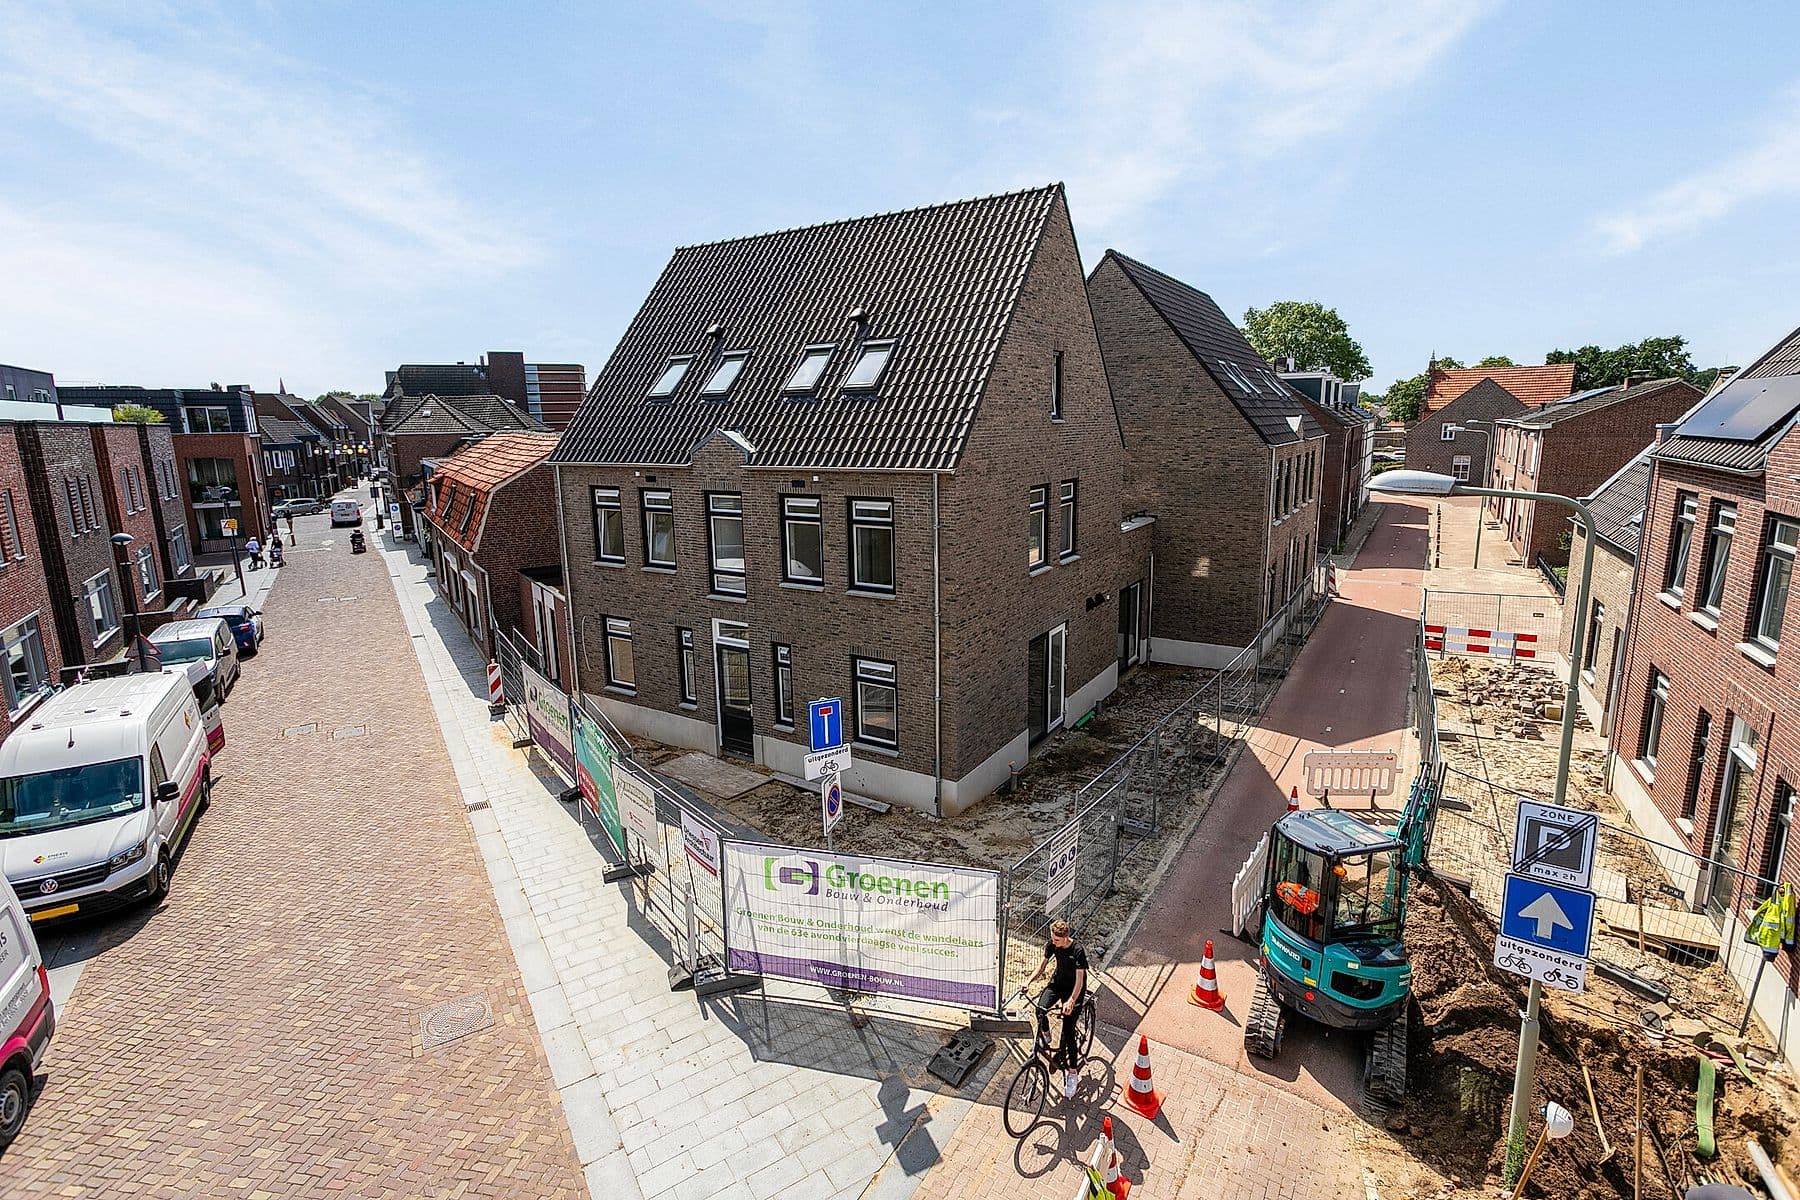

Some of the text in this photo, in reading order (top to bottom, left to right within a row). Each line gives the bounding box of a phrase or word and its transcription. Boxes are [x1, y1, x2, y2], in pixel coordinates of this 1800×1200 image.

[807, 747, 848, 762] uitgezonderd
[1540, 809, 1575, 823] ZONE
[826, 864, 950, 900] Groenen
[1533, 865, 1577, 882] max 2h
[826, 889, 949, 912] Bouw & Onderhoud
[736, 907, 984, 948] Groenen Bouw & Onderhoud wenst de wandelaars
[757, 925, 959, 959] van de 63e avondvierdaagse veel succes.
[1500, 940, 1583, 971] uitgezonderd
[810, 965, 905, 987] WWW.GROENEN-BOUW.NL
